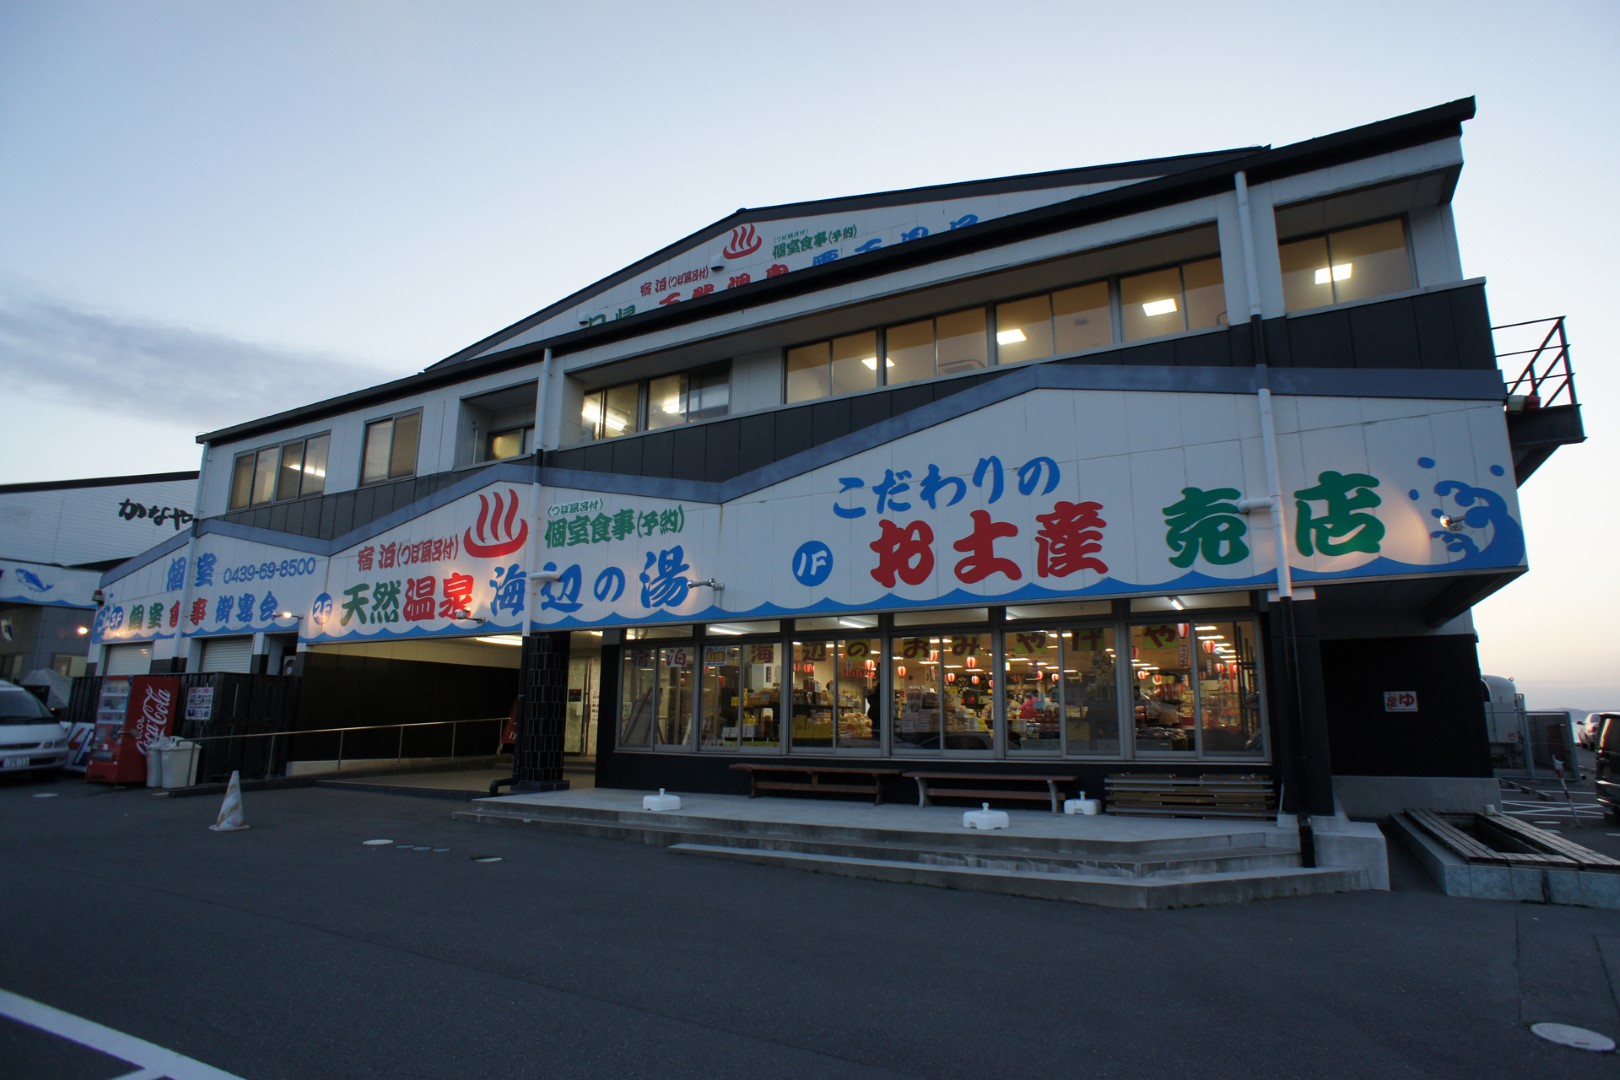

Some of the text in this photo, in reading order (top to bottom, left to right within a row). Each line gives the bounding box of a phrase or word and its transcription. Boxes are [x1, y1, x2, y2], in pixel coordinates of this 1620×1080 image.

[547, 498, 604, 517] (つぼ風呂付)
[832, 455, 1060, 519] こだわりの
[118, 498, 193, 530] かなや
[545, 504, 684, 549] 個室食事(予約)
[795, 470, 1386, 587] 1F お土産 売店
[223, 557, 316, 584] 0439-69-8500
[357, 533, 459, 572] 宿泊(つぼ風呂付)
[340, 573, 475, 627] 天然温泉
[490, 544, 690, 617] 海辺の湯
[136, 685, 171, 755] Coca-Cola
